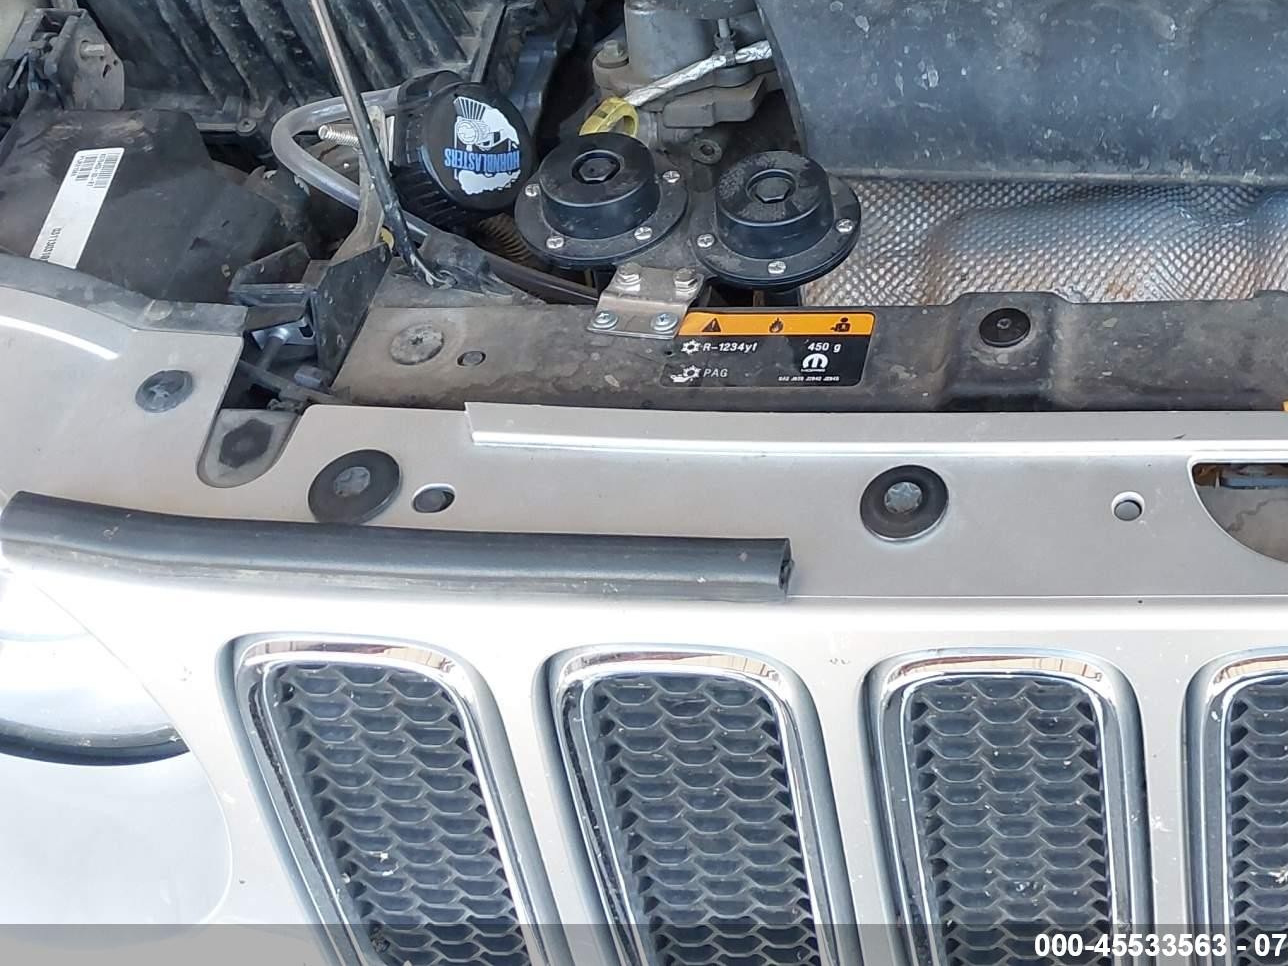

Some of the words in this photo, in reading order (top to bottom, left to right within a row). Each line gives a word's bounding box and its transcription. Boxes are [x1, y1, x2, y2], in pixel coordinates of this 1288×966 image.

[444, 147, 521, 174] HORNBLASTERS
[701, 341, 758, 354] R-1234yf
[807, 341, 830, 352] 450
[833, 343, 842, 353] g
[702, 368, 729, 379] PAG
